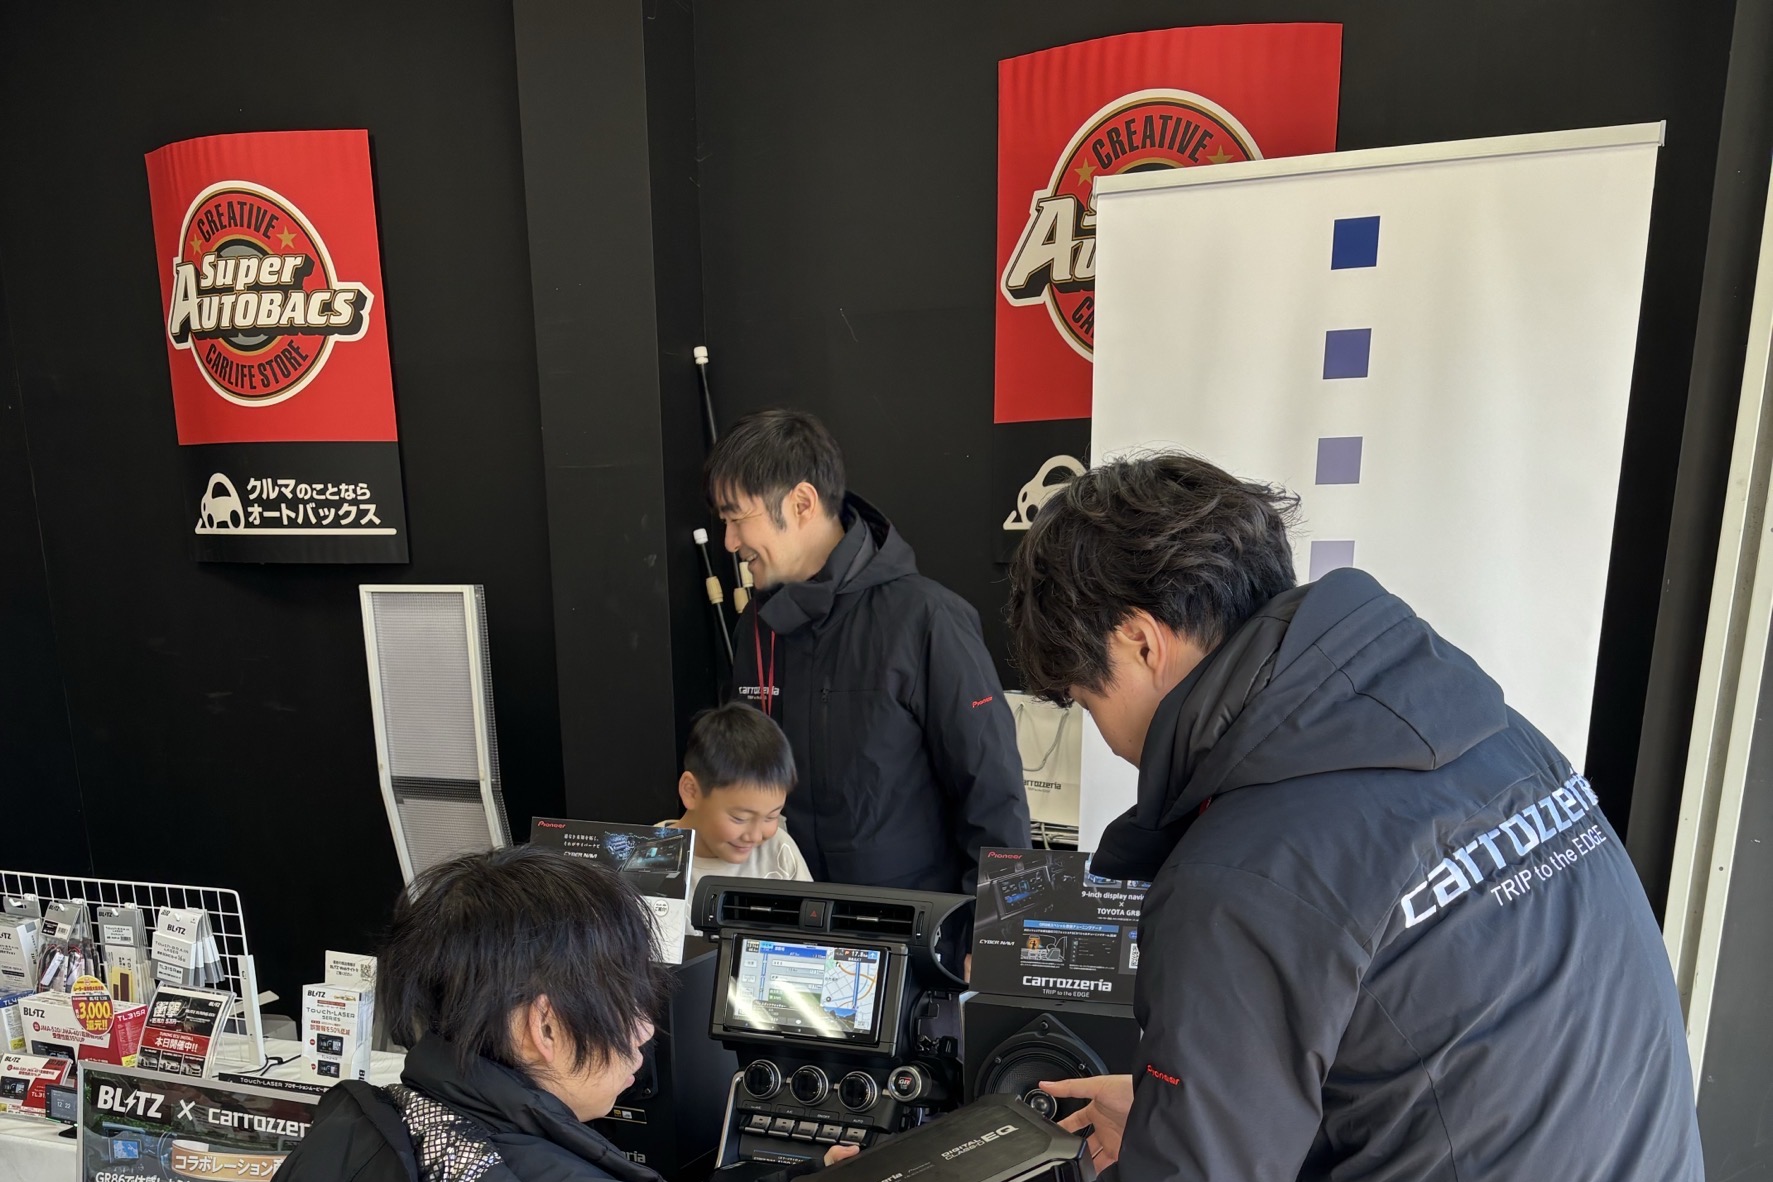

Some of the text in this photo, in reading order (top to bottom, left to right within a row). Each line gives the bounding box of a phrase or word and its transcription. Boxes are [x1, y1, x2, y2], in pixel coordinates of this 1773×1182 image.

[1092, 115, 1212, 169] CREATIVE
[197, 200, 278, 242] CREATIVE
[201, 254, 303, 290] Super
[172, 265, 357, 334] AUTOBACS
[205, 340, 309, 390] CARLIFE STORE
[246, 477, 370, 500] クルマのことなら
[247, 502, 381, 526] オートバックス
[537, 820, 566, 829] Pioneer
[988, 852, 1022, 860] Pioneer
[1490, 824, 1607, 906] TRIP to the EDGE
[1103, 892, 1127, 901] display
[166, 924, 186, 936] BLITZ
[1022, 976, 1112, 992] carrozzeria
[308, 990, 326, 998] BLITZ
[24, 1006, 45, 1018] BLITZ
[118, 1008, 146, 1022] TL315R
[155, 1036, 198, 1052] 本日開催中!!
[240, 1078, 282, 1088] Touch-LASER
[97, 1085, 164, 1119] BLITZ
[980, 1124, 1020, 1143] EQ
